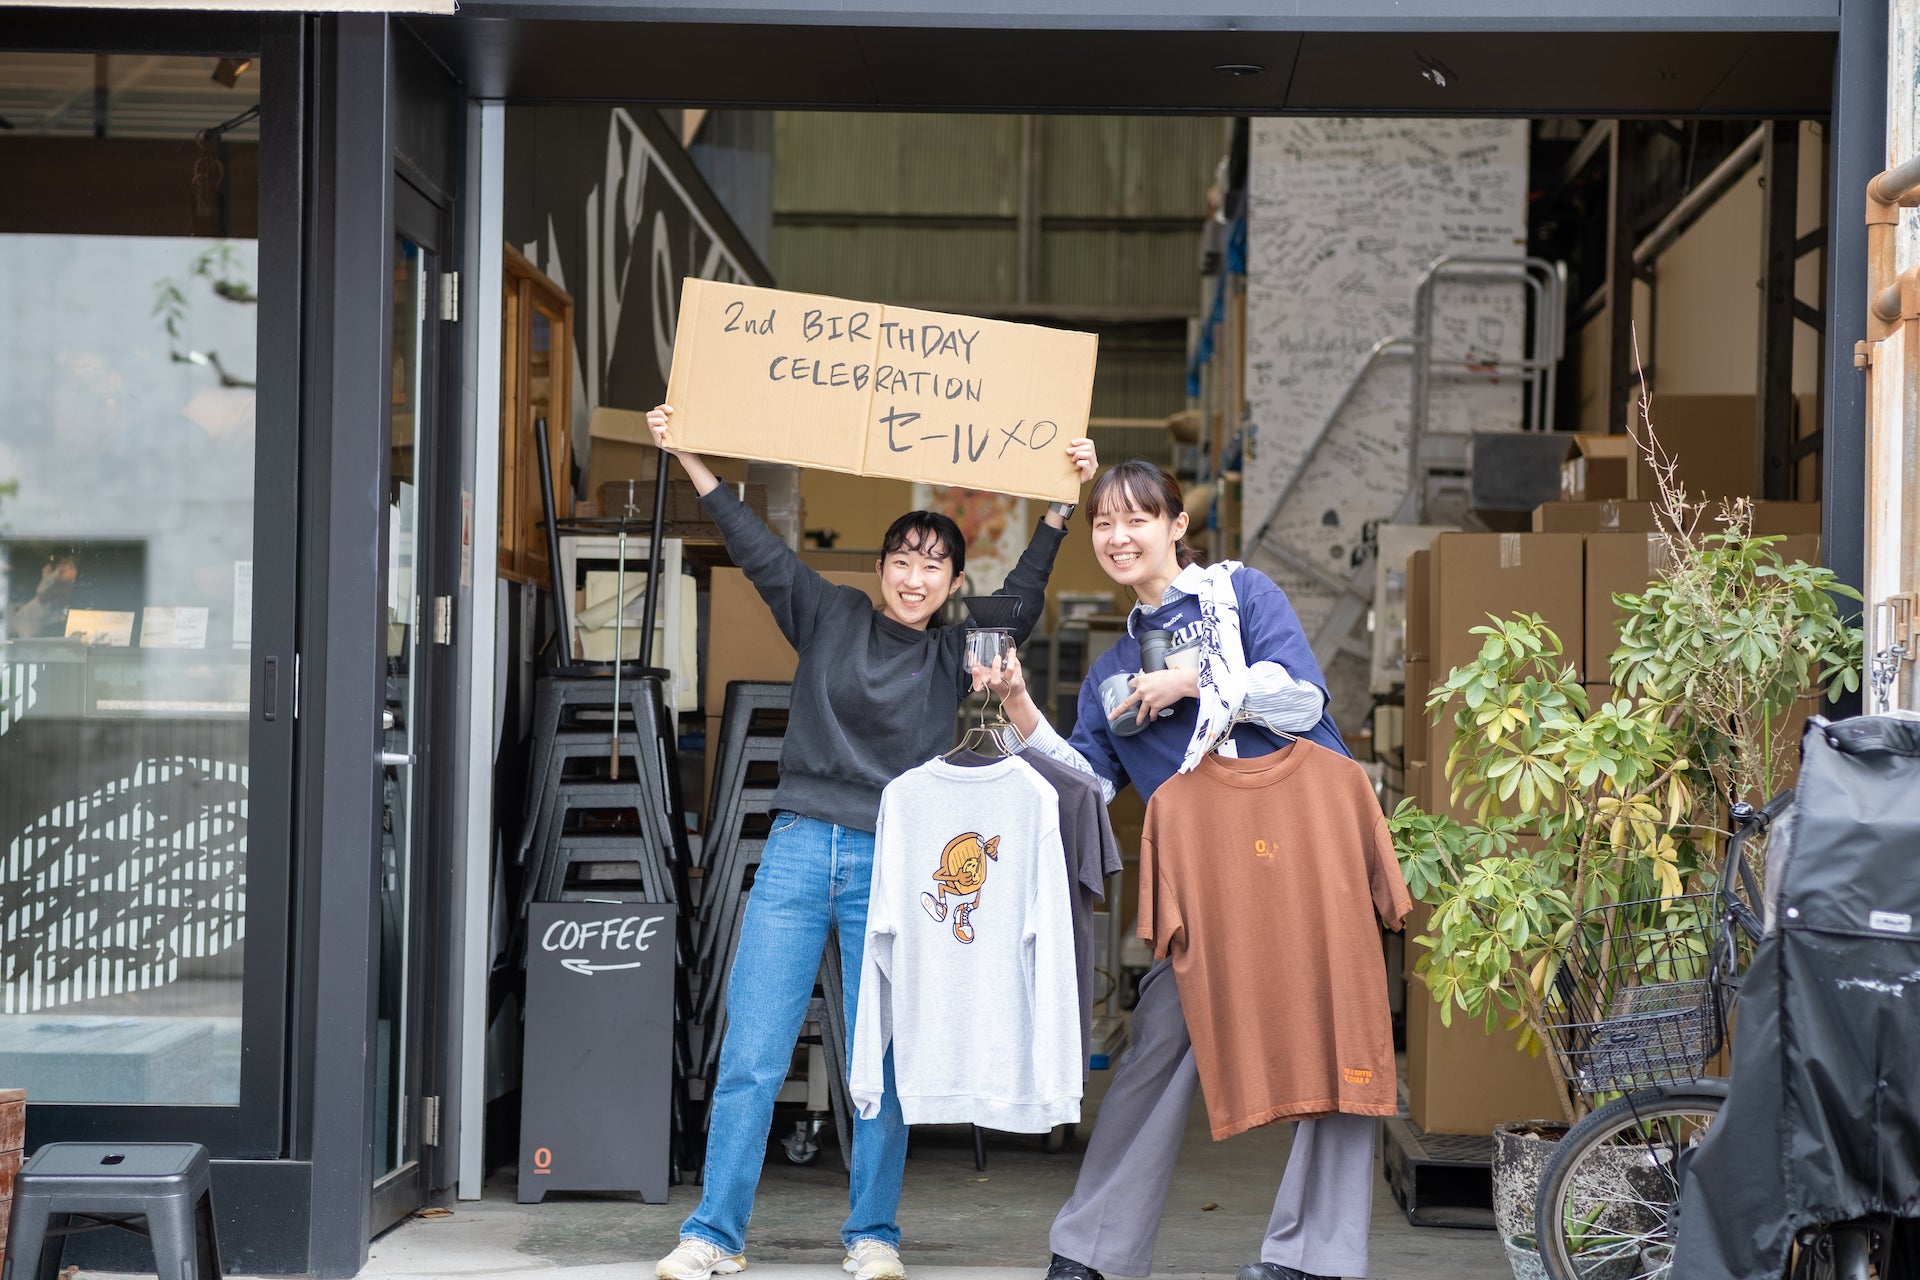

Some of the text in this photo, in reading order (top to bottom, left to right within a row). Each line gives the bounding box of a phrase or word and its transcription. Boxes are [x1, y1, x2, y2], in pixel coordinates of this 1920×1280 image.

[724, 301, 981, 365] 2nd BIRTHDAY
[769, 355, 983, 403] CELEBRATION
[1162, 611, 1184, 630] Reebok
[541, 916, 665, 952] COFFEE
